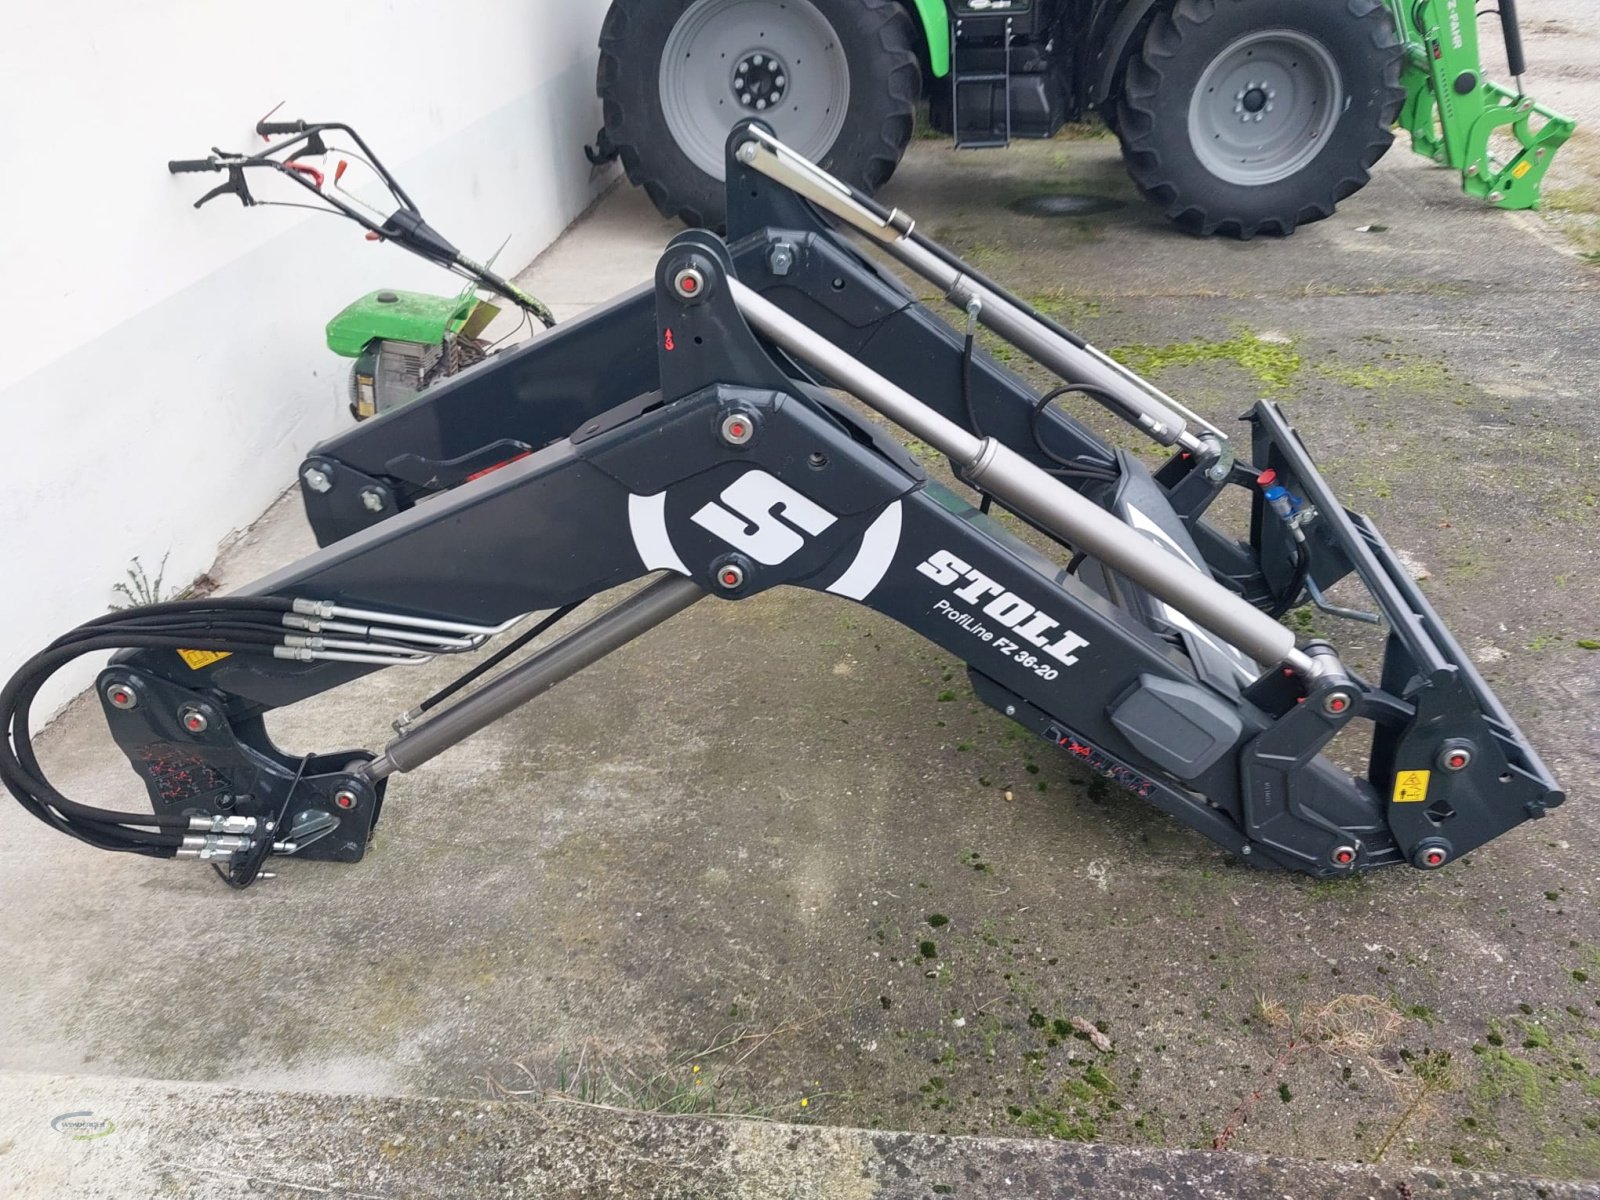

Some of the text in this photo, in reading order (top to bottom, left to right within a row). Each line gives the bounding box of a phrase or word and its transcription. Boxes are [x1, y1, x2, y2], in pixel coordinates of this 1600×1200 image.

[915, 549, 1090, 667] STOLL
[932, 599, 1059, 681] ProfiLine FZ 36-20
